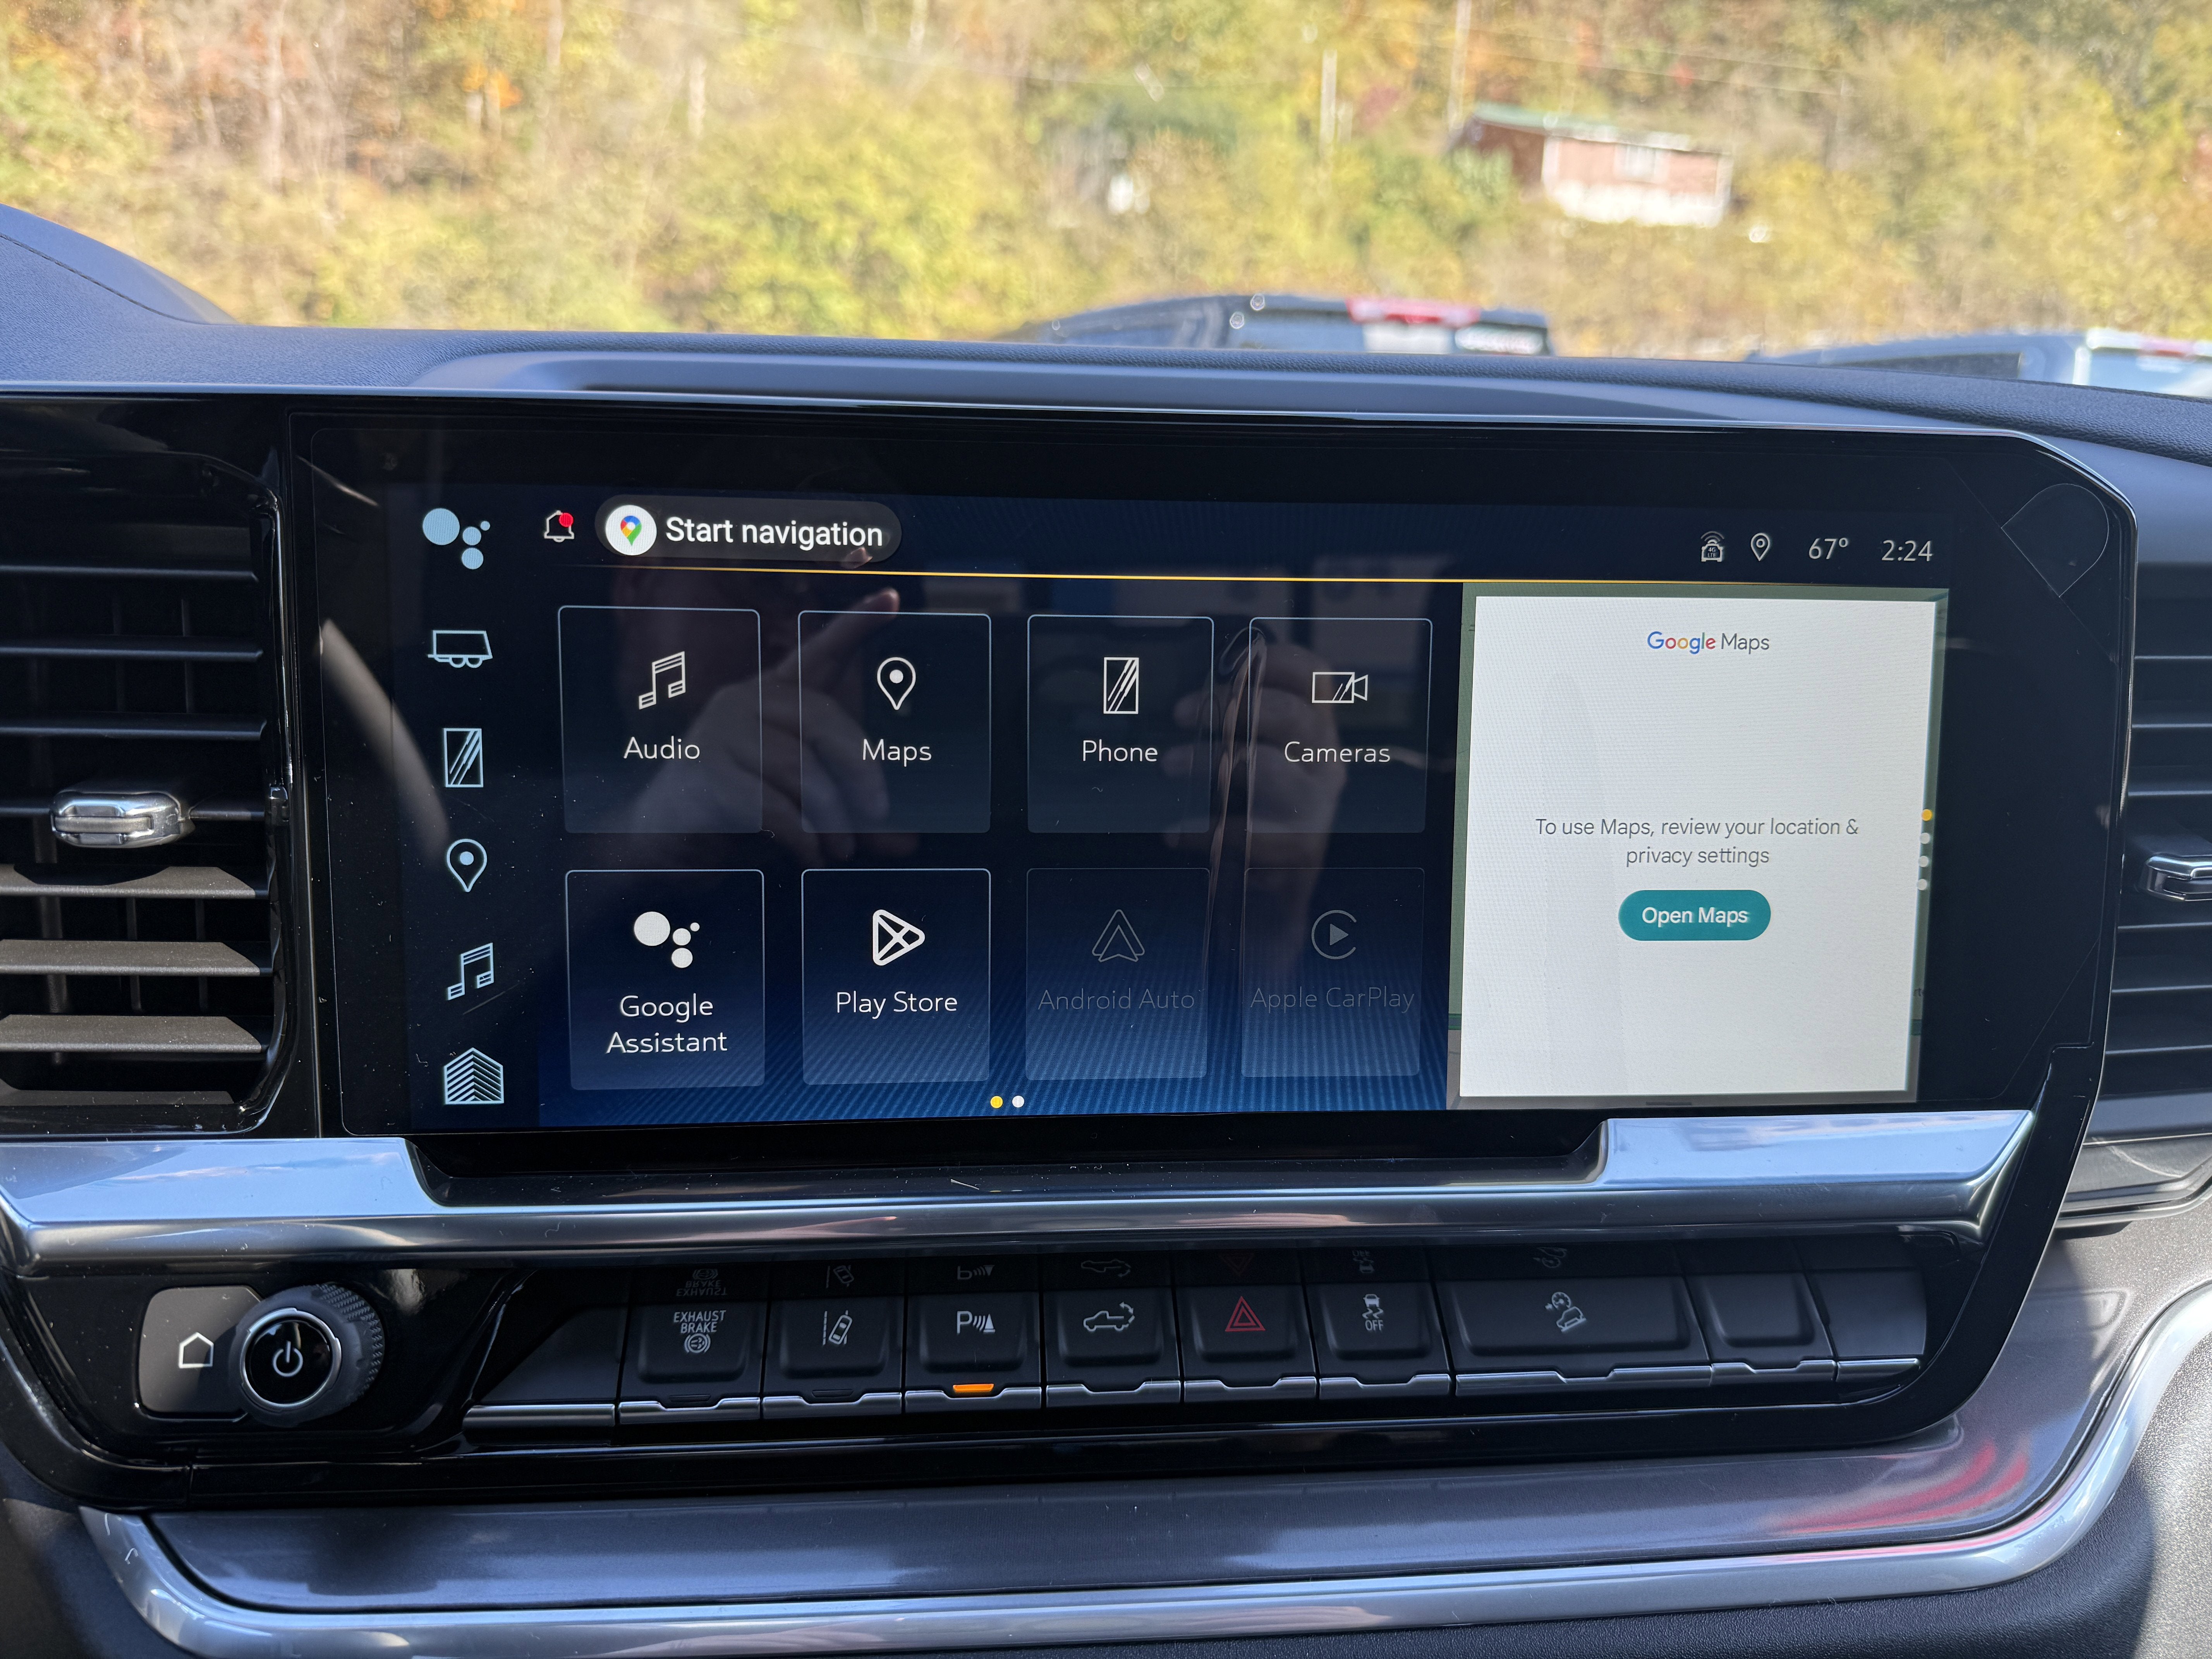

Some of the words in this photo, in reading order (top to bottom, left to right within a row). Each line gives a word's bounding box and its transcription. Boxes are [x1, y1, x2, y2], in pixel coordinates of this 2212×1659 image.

[666, 516, 733, 543] Start
[742, 520, 882, 551] navigation
[1882, 540, 1933, 562] 2:24
[1647, 631, 1716, 654] Google
[1721, 633, 1769, 654] Maps
[623, 735, 700, 759] Audio
[863, 738, 932, 767] Maps
[1083, 739, 1158, 762] Phone
[1285, 741, 1390, 762] Cameras
[1535, 819, 1556, 835] To
[1563, 823, 1594, 835] use
[1601, 819, 1654, 839] Maps,
[1662, 817, 1721, 835] review
[1724, 823, 1765, 839] your
[1771, 817, 1840, 835] location
[1846, 818, 1858, 835] &
[1626, 846, 1693, 867] privacy
[1698, 846, 1769, 867] settings
[1642, 907, 1693, 927] Open
[1698, 907, 1748, 927] Maps
[620, 993, 713, 1023] Google
[837, 990, 886, 1019] Play
[893, 991, 958, 1012] Store
[1038, 988, 1131, 1010] Android
[1139, 988, 1194, 1009] Auto
[1250, 986, 1317, 1014] Apple
[1326, 986, 1414, 1013] CarPlay
[606, 1032, 728, 1053] Assistant
[673, 1310, 726, 1323] EXHAUST
[681, 1322, 718, 1333] BRAKE
[1365, 1320, 1383, 1331] OFF
